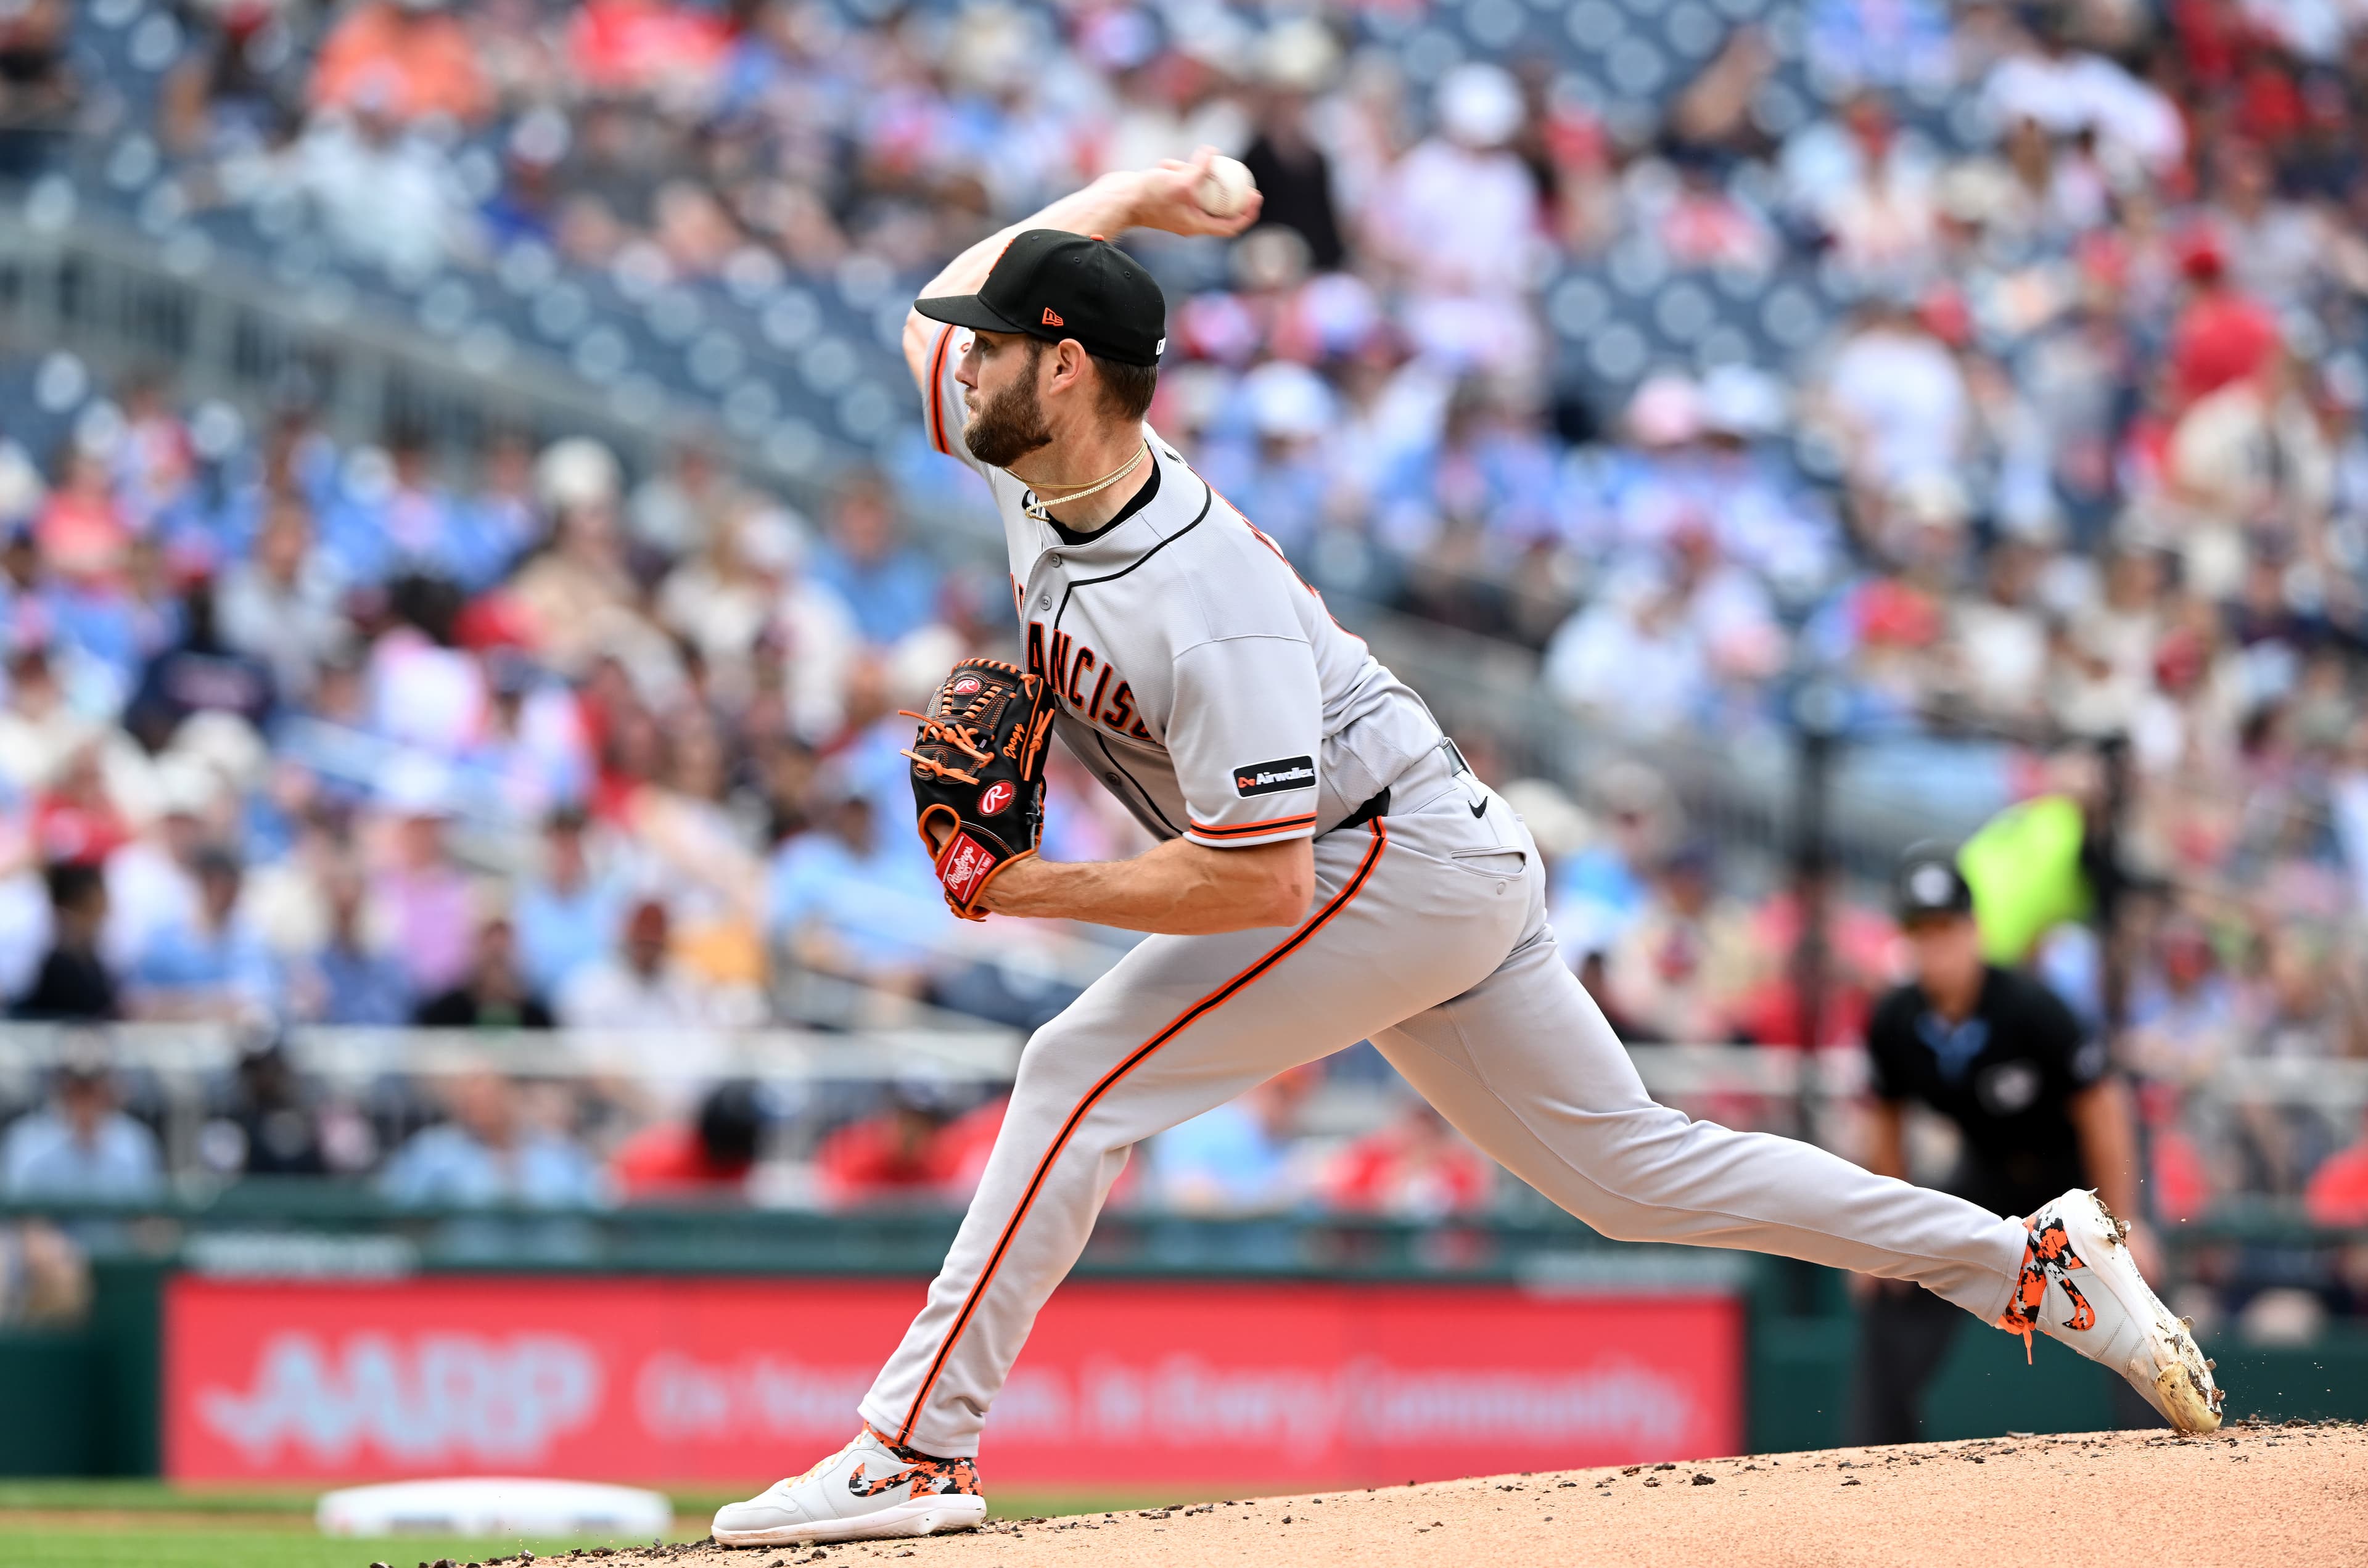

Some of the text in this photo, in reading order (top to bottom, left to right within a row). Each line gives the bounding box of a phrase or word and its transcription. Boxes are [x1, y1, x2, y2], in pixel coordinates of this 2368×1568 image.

[982, 785, 1011, 813] R
[947, 846, 976, 890] Rawlings
[199, 1333, 599, 1465] AARP
